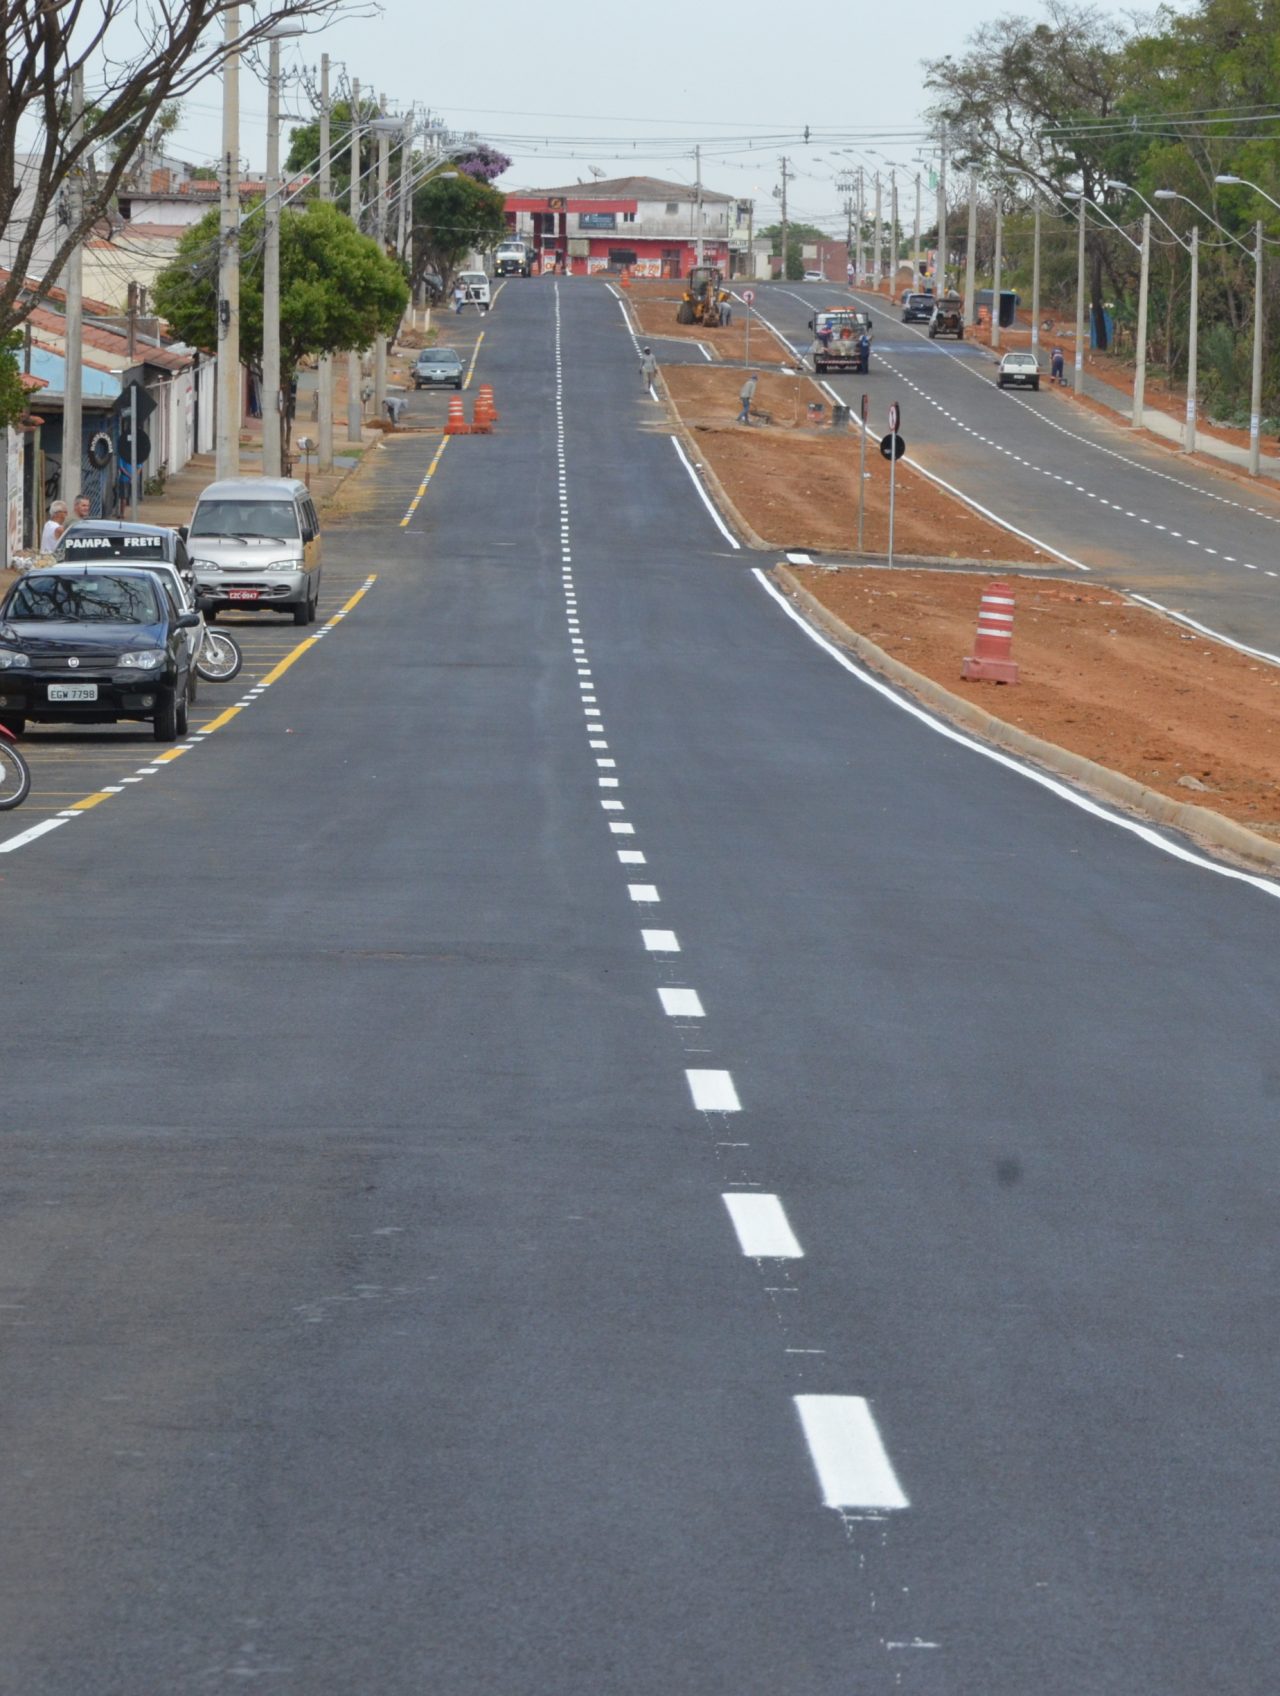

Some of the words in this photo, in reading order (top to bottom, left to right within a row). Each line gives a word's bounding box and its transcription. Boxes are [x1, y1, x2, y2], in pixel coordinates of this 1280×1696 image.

[65, 538, 111, 548] PAMPA
[124, 537, 161, 546] FRETE
[51, 691, 68, 699] EGW
[72, 690, 95, 699] 7798
